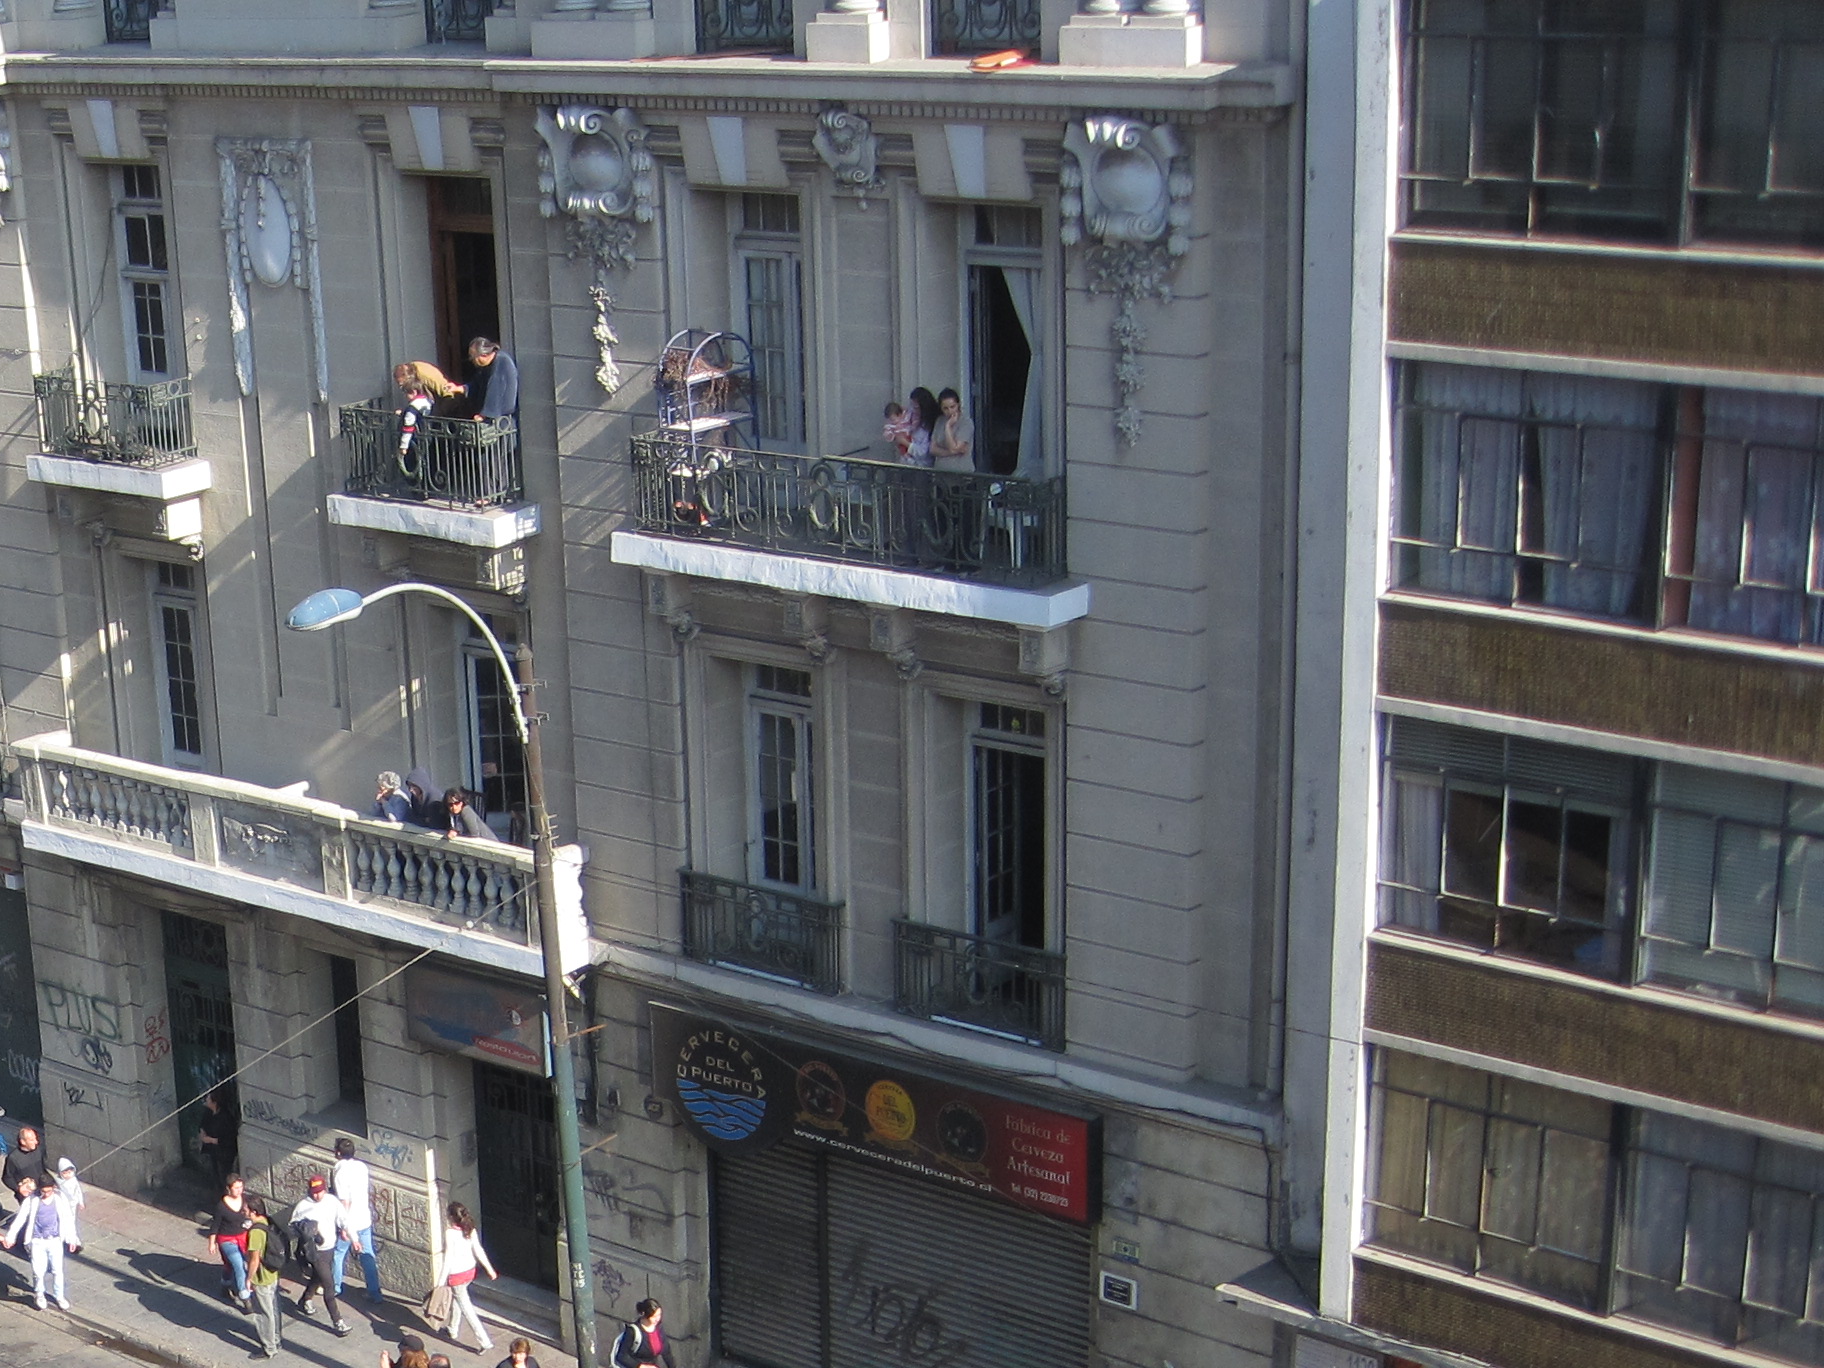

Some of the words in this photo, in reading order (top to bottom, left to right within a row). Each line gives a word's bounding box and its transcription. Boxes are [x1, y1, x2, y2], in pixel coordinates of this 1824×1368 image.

[676, 1030, 767, 1100] CERVECERA
[705, 1056, 735, 1072] DEL
[691, 1066, 753, 1092] PUERTO
[1011, 1137, 1065, 1164] Cerveza
[1056, 1129, 1072, 1145] de
[793, 1127, 992, 1192] www.cerveceradelpuerto.cl
[1007, 1155, 1071, 1185] Artesanal
